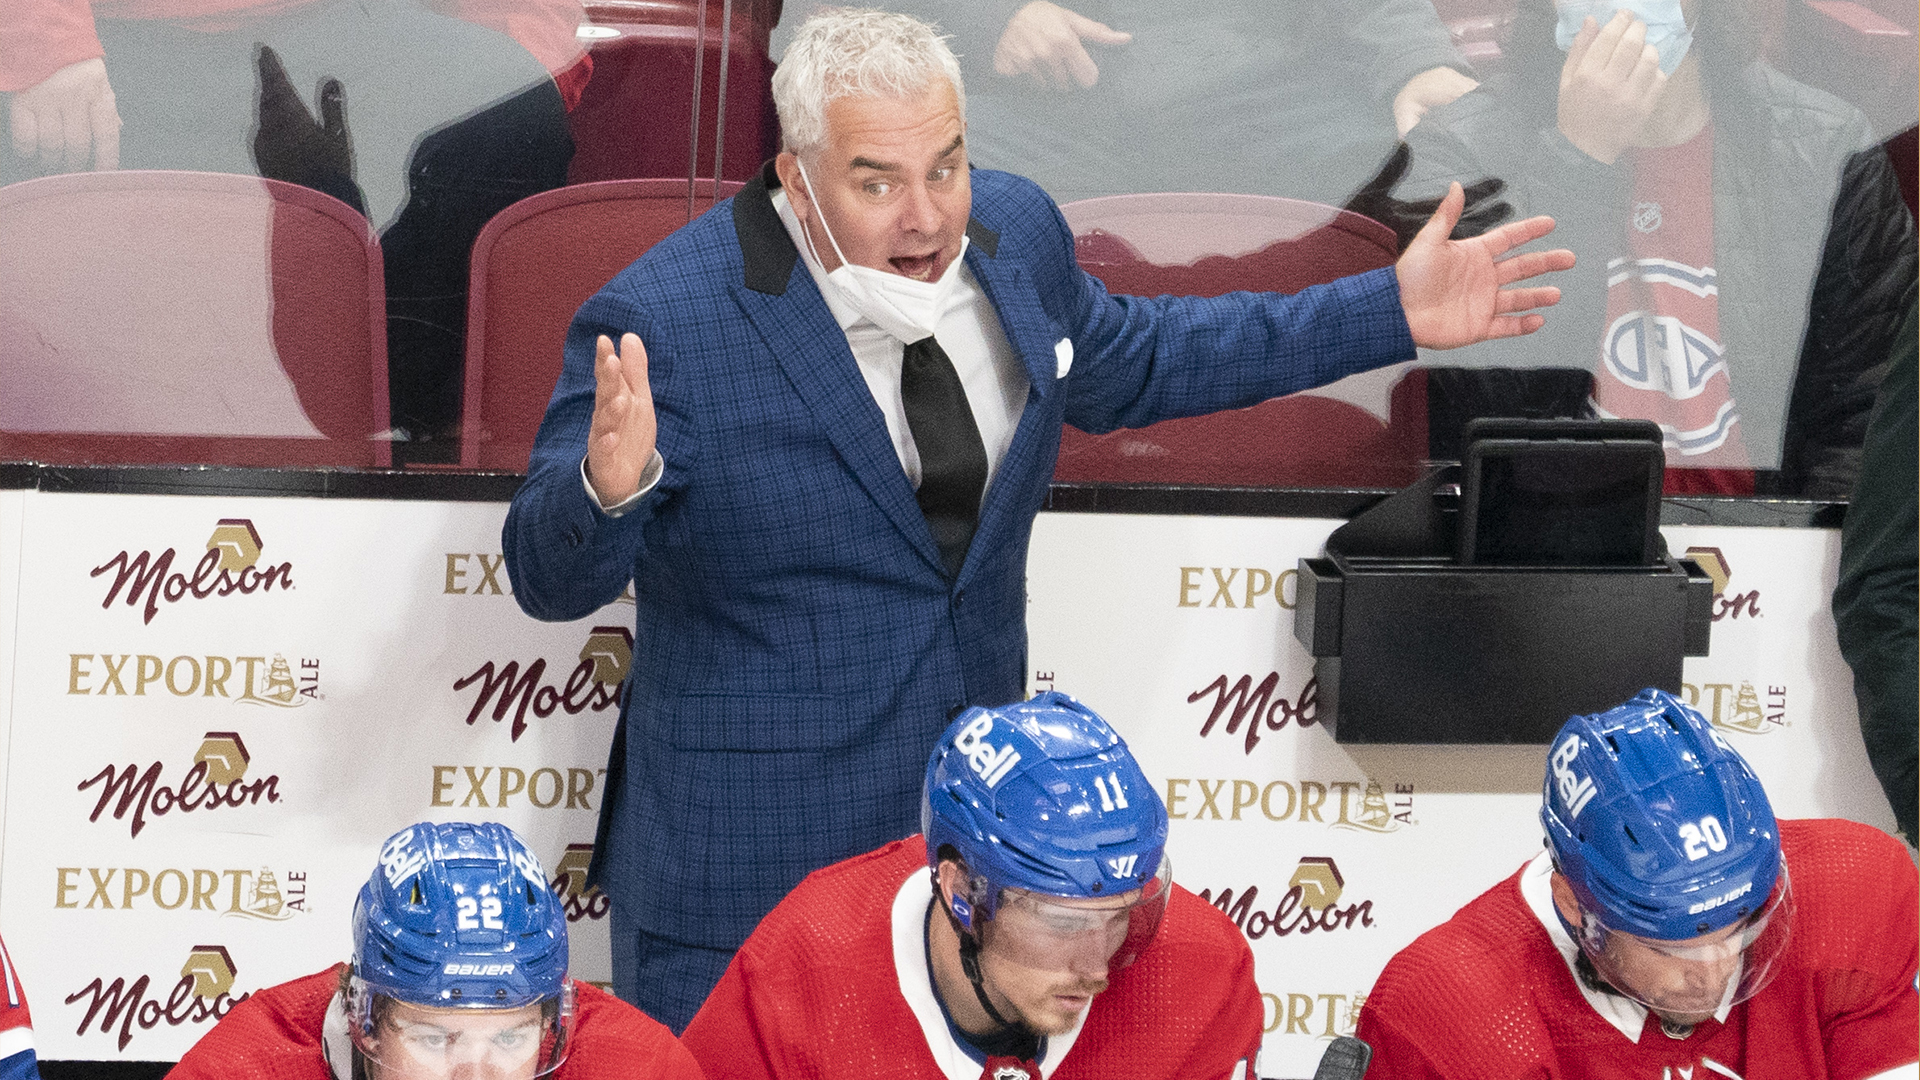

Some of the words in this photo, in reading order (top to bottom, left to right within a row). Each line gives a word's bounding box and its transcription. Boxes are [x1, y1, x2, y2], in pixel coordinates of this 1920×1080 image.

[90, 548, 292, 626] Molson
[1177, 566, 1298, 610] EXPO
[66, 653, 266, 701] EXPORT
[300, 658, 320, 699] ALE
[453, 657, 624, 743] Mols
[1035, 670, 1055, 694] LE
[1187, 671, 1318, 756] Mol
[1767, 684, 1787, 726] ALE
[955, 713, 1022, 788] Bell
[77, 760, 280, 840] Molson
[429, 765, 607, 810] EXPOR
[1094, 772, 1129, 812] 11
[1552, 734, 1598, 820] Bell
[1164, 778, 1361, 824] EXPORT
[1393, 783, 1414, 824] ALE
[379, 829, 426, 890] Bell
[1678, 816, 1728, 862] 20
[53, 866, 254, 913] EXPORT
[286, 870, 307, 912] ALE
[456, 896, 504, 930] 22
[64, 974, 250, 1053] Molso
[1261, 992, 1347, 1038] ORT
